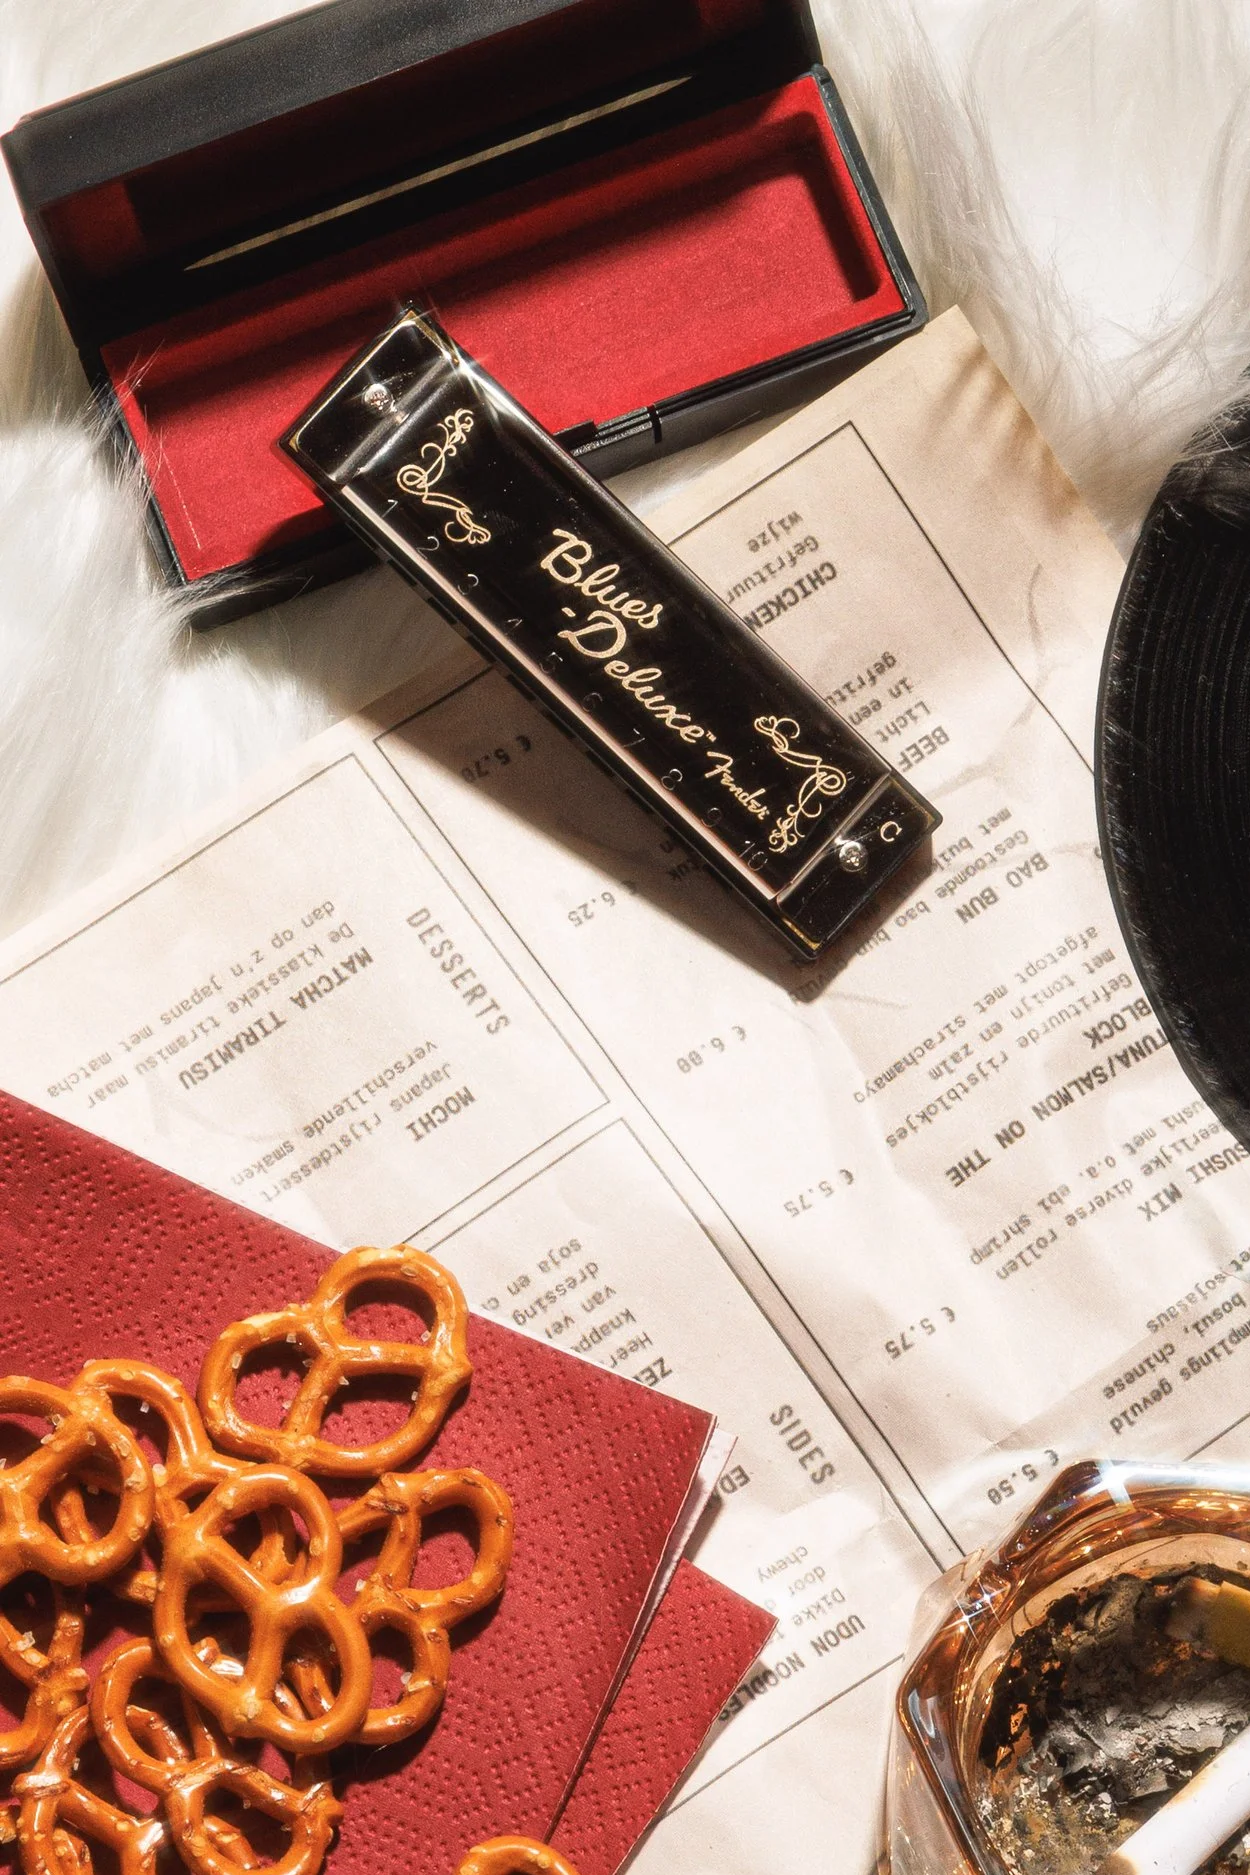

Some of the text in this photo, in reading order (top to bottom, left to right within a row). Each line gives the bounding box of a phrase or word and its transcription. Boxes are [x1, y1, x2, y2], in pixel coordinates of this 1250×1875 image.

[747, 511, 802, 552] wijze
[540, 528, 664, 629] Blues
[382, 499, 399, 519] 1
[416, 536, 440, 560] 2
[457, 573, 479, 596] 3
[539, 651, 564, 674] 5
[582, 692, 603, 713] 6
[622, 728, 646, 748] 7
[661, 768, 683, 791] 8
[701, 807, 722, 828] 9
[738, 840, 768, 872] 10
[875, 700, 930, 742] Licht
[898, 725, 949, 772] BEEF
[704, 750, 771, 821] Fender
[879, 820, 902, 842] C
[894, 829, 1028, 927] Gestoomde bao
[955, 852, 1048, 923] BAO BUN
[46, 900, 335, 1097] dan op z'n japans met matcha
[405, 907, 510, 1034] DESSERTS
[87, 921, 354, 1108] De klassieke tiramisu maar
[178, 946, 373, 1089] MATCHA TIRAMISU
[852, 925, 1098, 1103] afgetopt sirachamayo
[928, 974, 1075, 1080] tonijn zalm
[1082, 997, 1152, 1049] BLOCK
[675, 1036, 725, 1073] 6.00
[885, 972, 1132, 1148] Gefrituurde rijstblokjes
[230, 1041, 437, 1189] verschillende smaken
[389, 1062, 450, 1111] Japans
[405, 1085, 475, 1141] MOCHI
[945, 1020, 1173, 1187] TUNA/SALMON ON THE
[783, 1180, 834, 1217] 5.75
[969, 1155, 1116, 1264] o.a. ebi shrimp
[995, 1178, 1133, 1279] diverse rollen
[1136, 1182, 1182, 1221] MIX
[511, 1261, 599, 1326] dressing
[1145, 1272, 1226, 1333] sojasaus
[1182, 1292, 1246, 1337] bosui,
[884, 1317, 936, 1359] 5.75
[1102, 1342, 1175, 1399] chinese
[1109, 1378, 1172, 1434] gevuld
[769, 1404, 835, 1485] SIDES
[987, 1463, 1038, 1505] 5.50
[757, 1545, 808, 1582] chewy
[793, 1587, 846, 1626] Dikke
[810, 1614, 865, 1656] UDON
